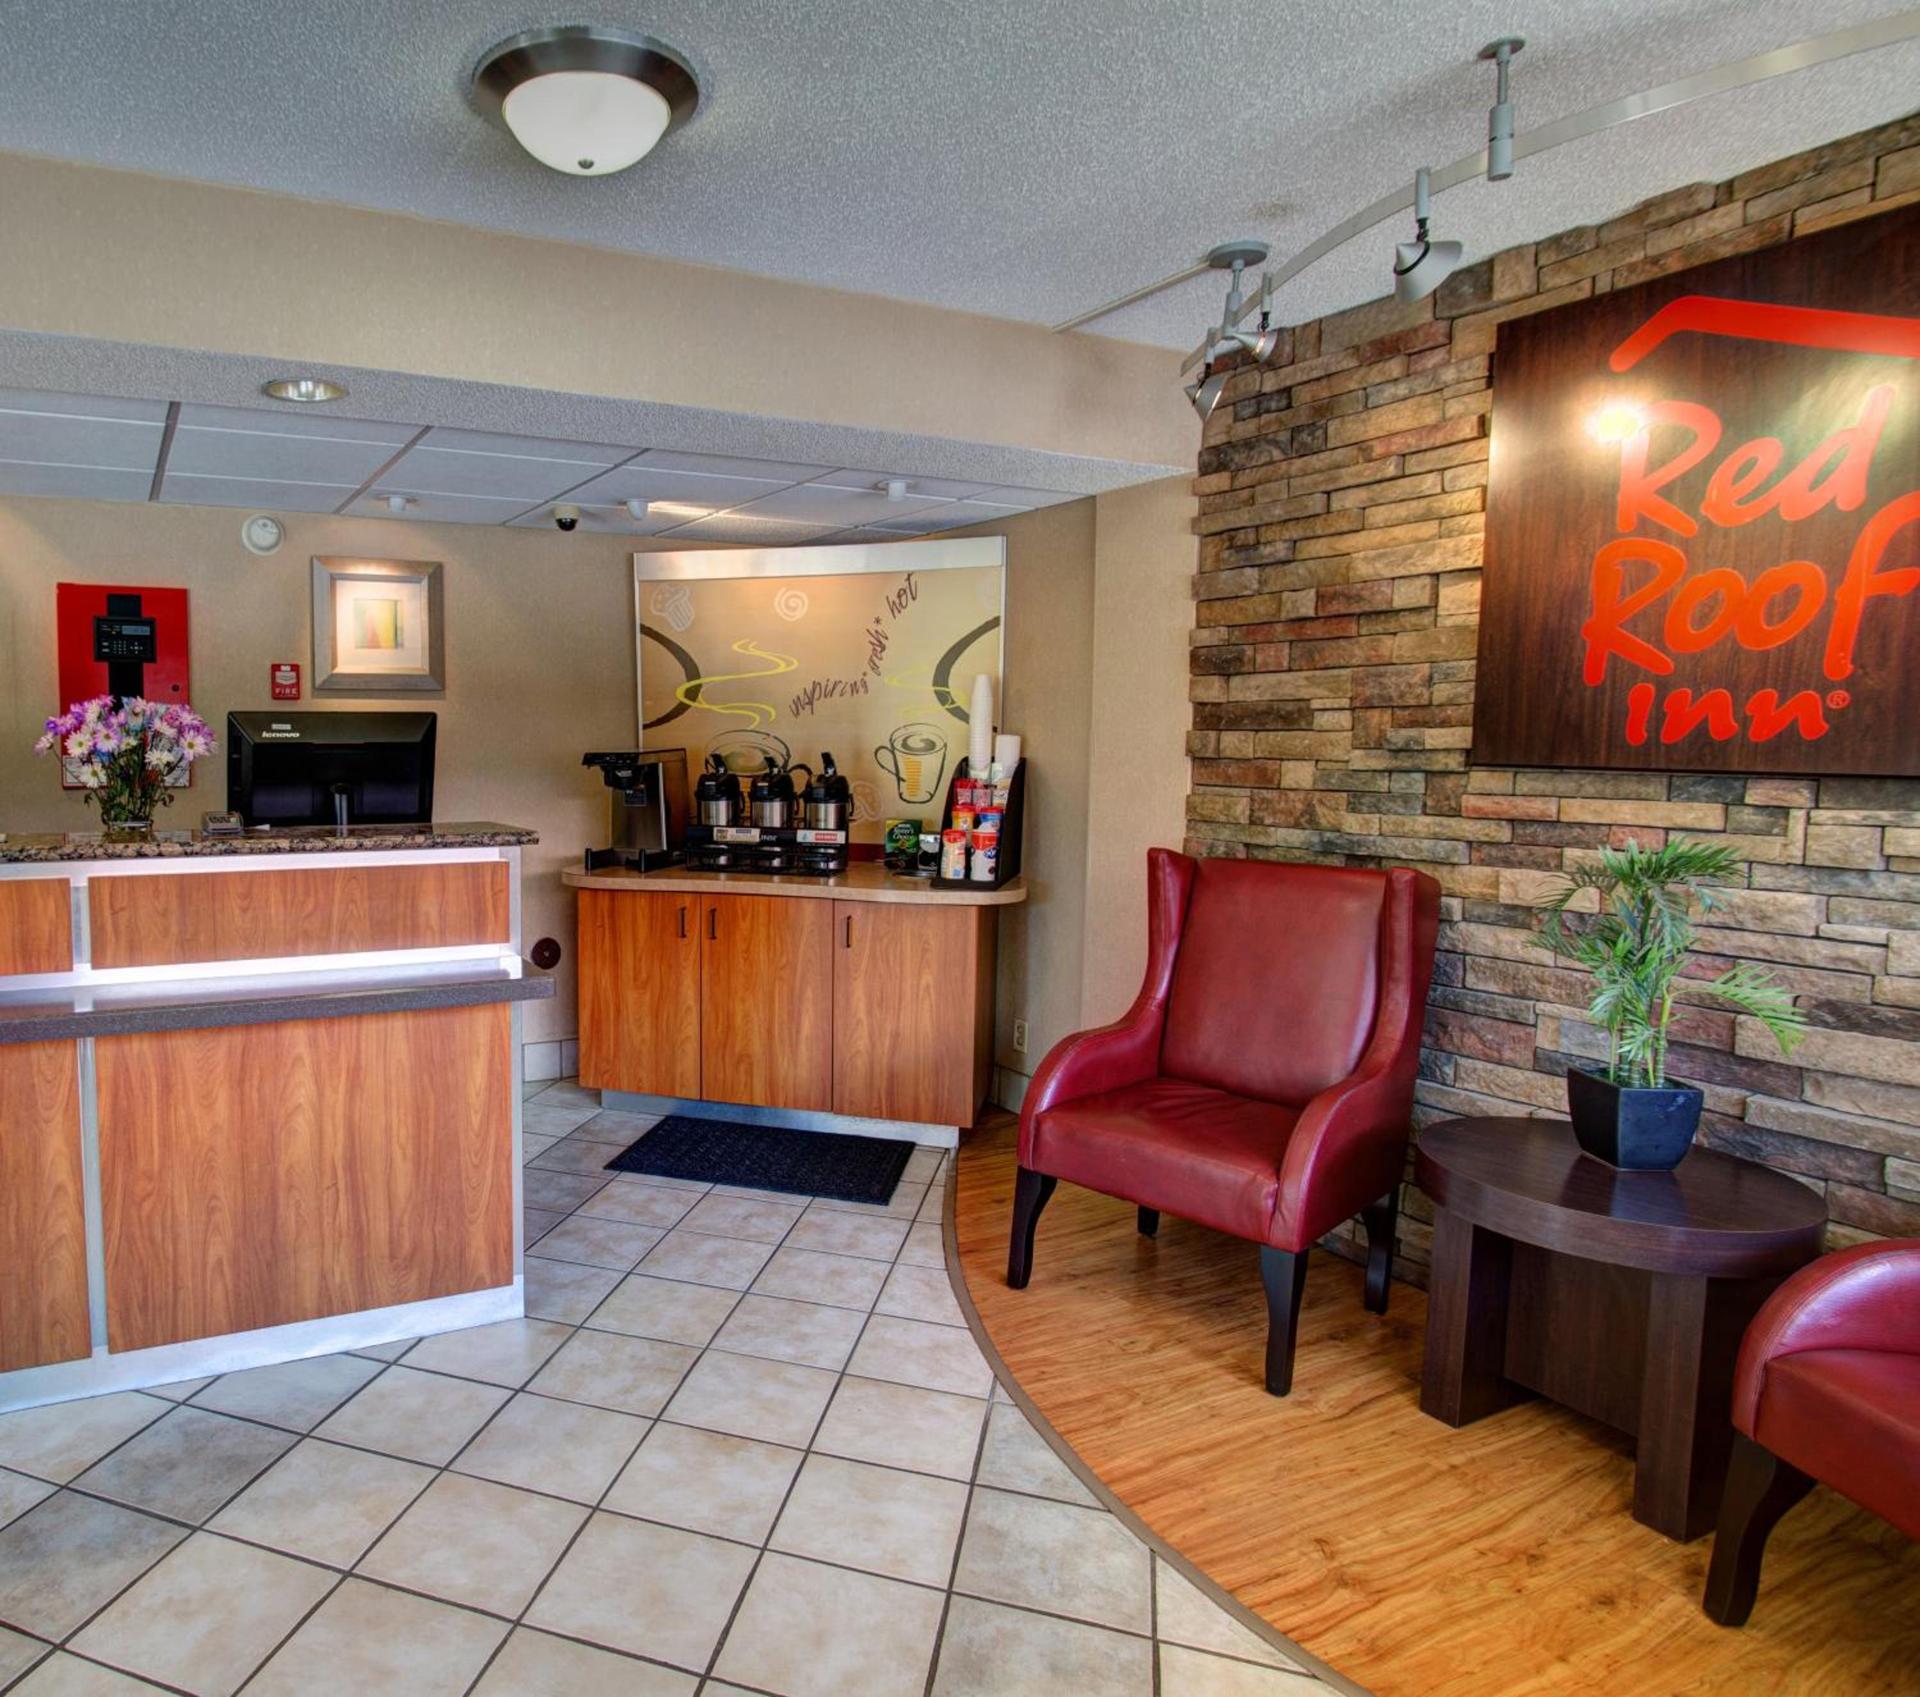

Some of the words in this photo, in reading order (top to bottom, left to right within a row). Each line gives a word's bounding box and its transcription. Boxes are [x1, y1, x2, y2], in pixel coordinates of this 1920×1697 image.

[1617, 385, 1894, 537] Red
[885, 571, 918, 620] hot
[1583, 491, 1920, 686] Roof
[261, 730, 300, 738] lenovo
